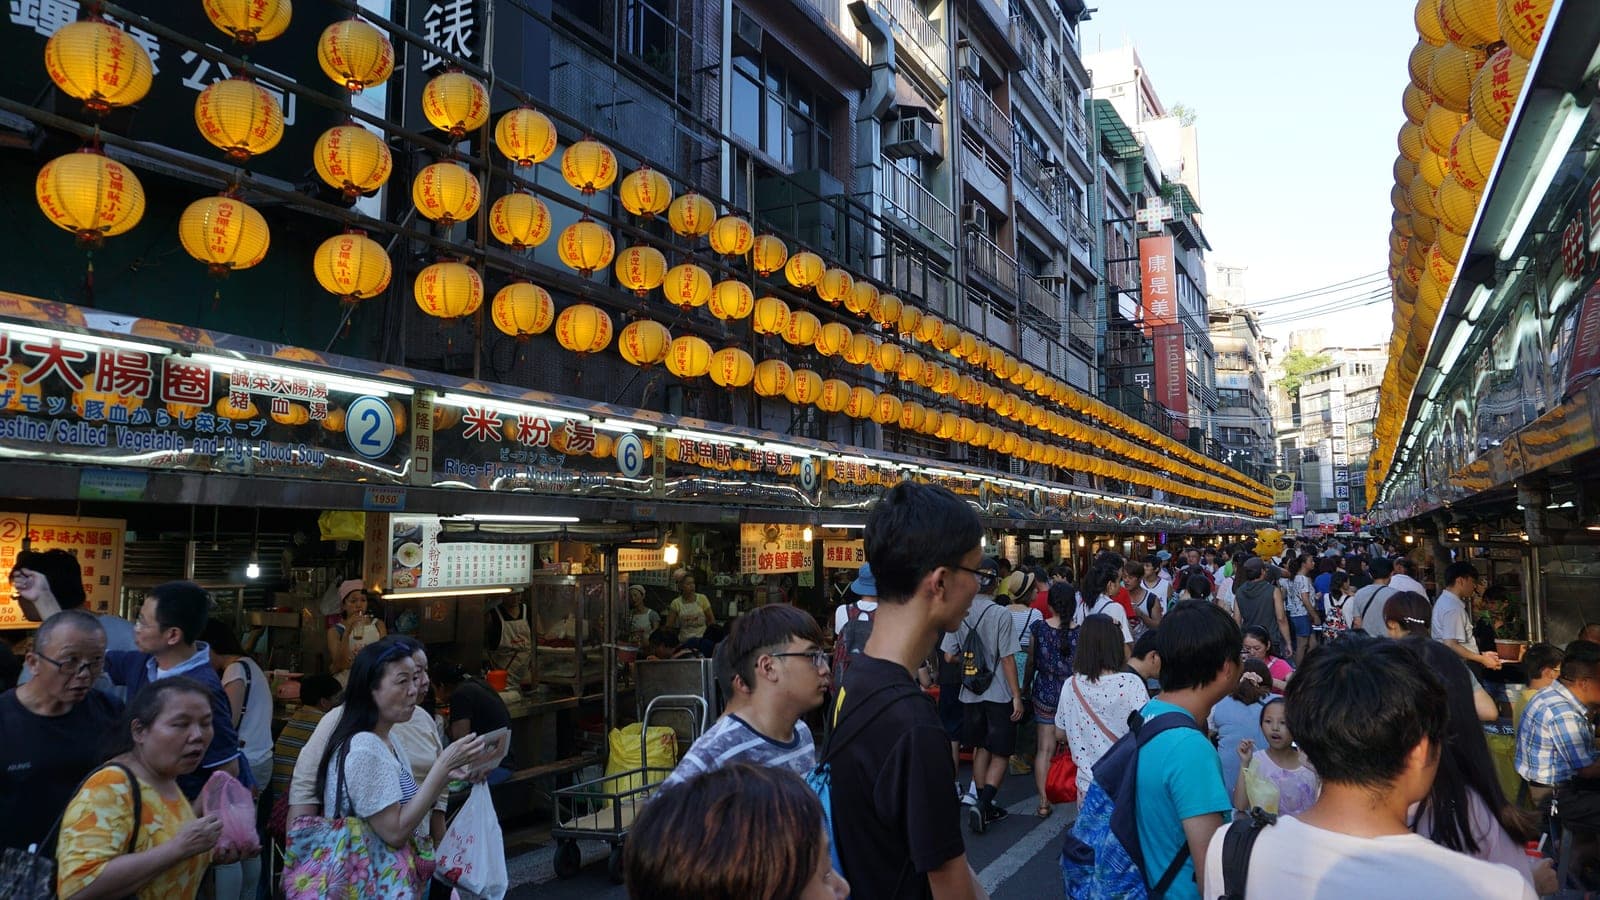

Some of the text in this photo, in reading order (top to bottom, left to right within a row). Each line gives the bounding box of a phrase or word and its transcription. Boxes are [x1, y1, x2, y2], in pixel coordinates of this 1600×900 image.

[1148, 254, 1170, 317] 康是美
[230, 367, 328, 399] 鹹菜大腸湯
[360, 408, 381, 447] 2
[462, 405, 597, 452] 米粉湯
[116, 425, 185, 453] Vegetable
[193, 436, 219, 456] and
[224, 437, 252, 462] Pig's
[260, 440, 292, 463] Blood
[299, 444, 326, 468] Soup
[624, 442, 637, 471] 6
[678, 437, 793, 473] 旗魚飯 鮮魚湯
[444, 458, 608, 487] Rice-Flour Noodles Soup
[804, 463, 812, 485] 8
[3, 522, 16, 538] 2
[803, 556, 812, 567] 55
[428, 578, 440, 588] 25
